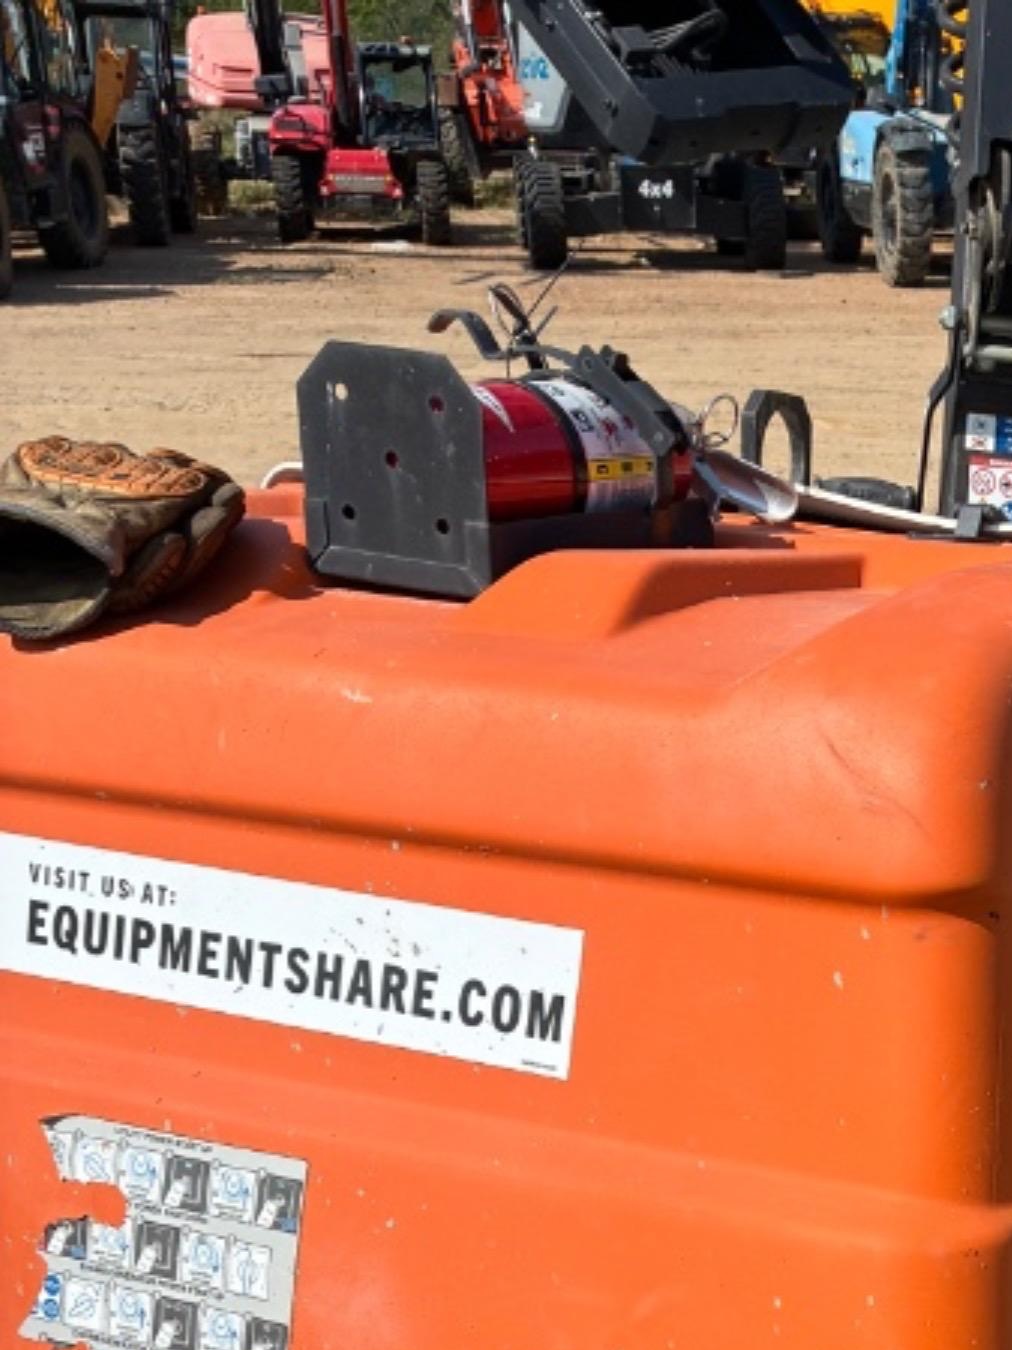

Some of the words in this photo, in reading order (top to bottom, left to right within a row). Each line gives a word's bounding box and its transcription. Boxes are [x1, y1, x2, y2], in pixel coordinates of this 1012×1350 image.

[638, 179, 674, 198] 4x4
[28, 862, 90, 892] VISIT
[101, 875, 130, 899] US
[141, 883, 177, 907] AT:
[26, 899, 567, 1042] EQUIPMENTSHARE.COM
